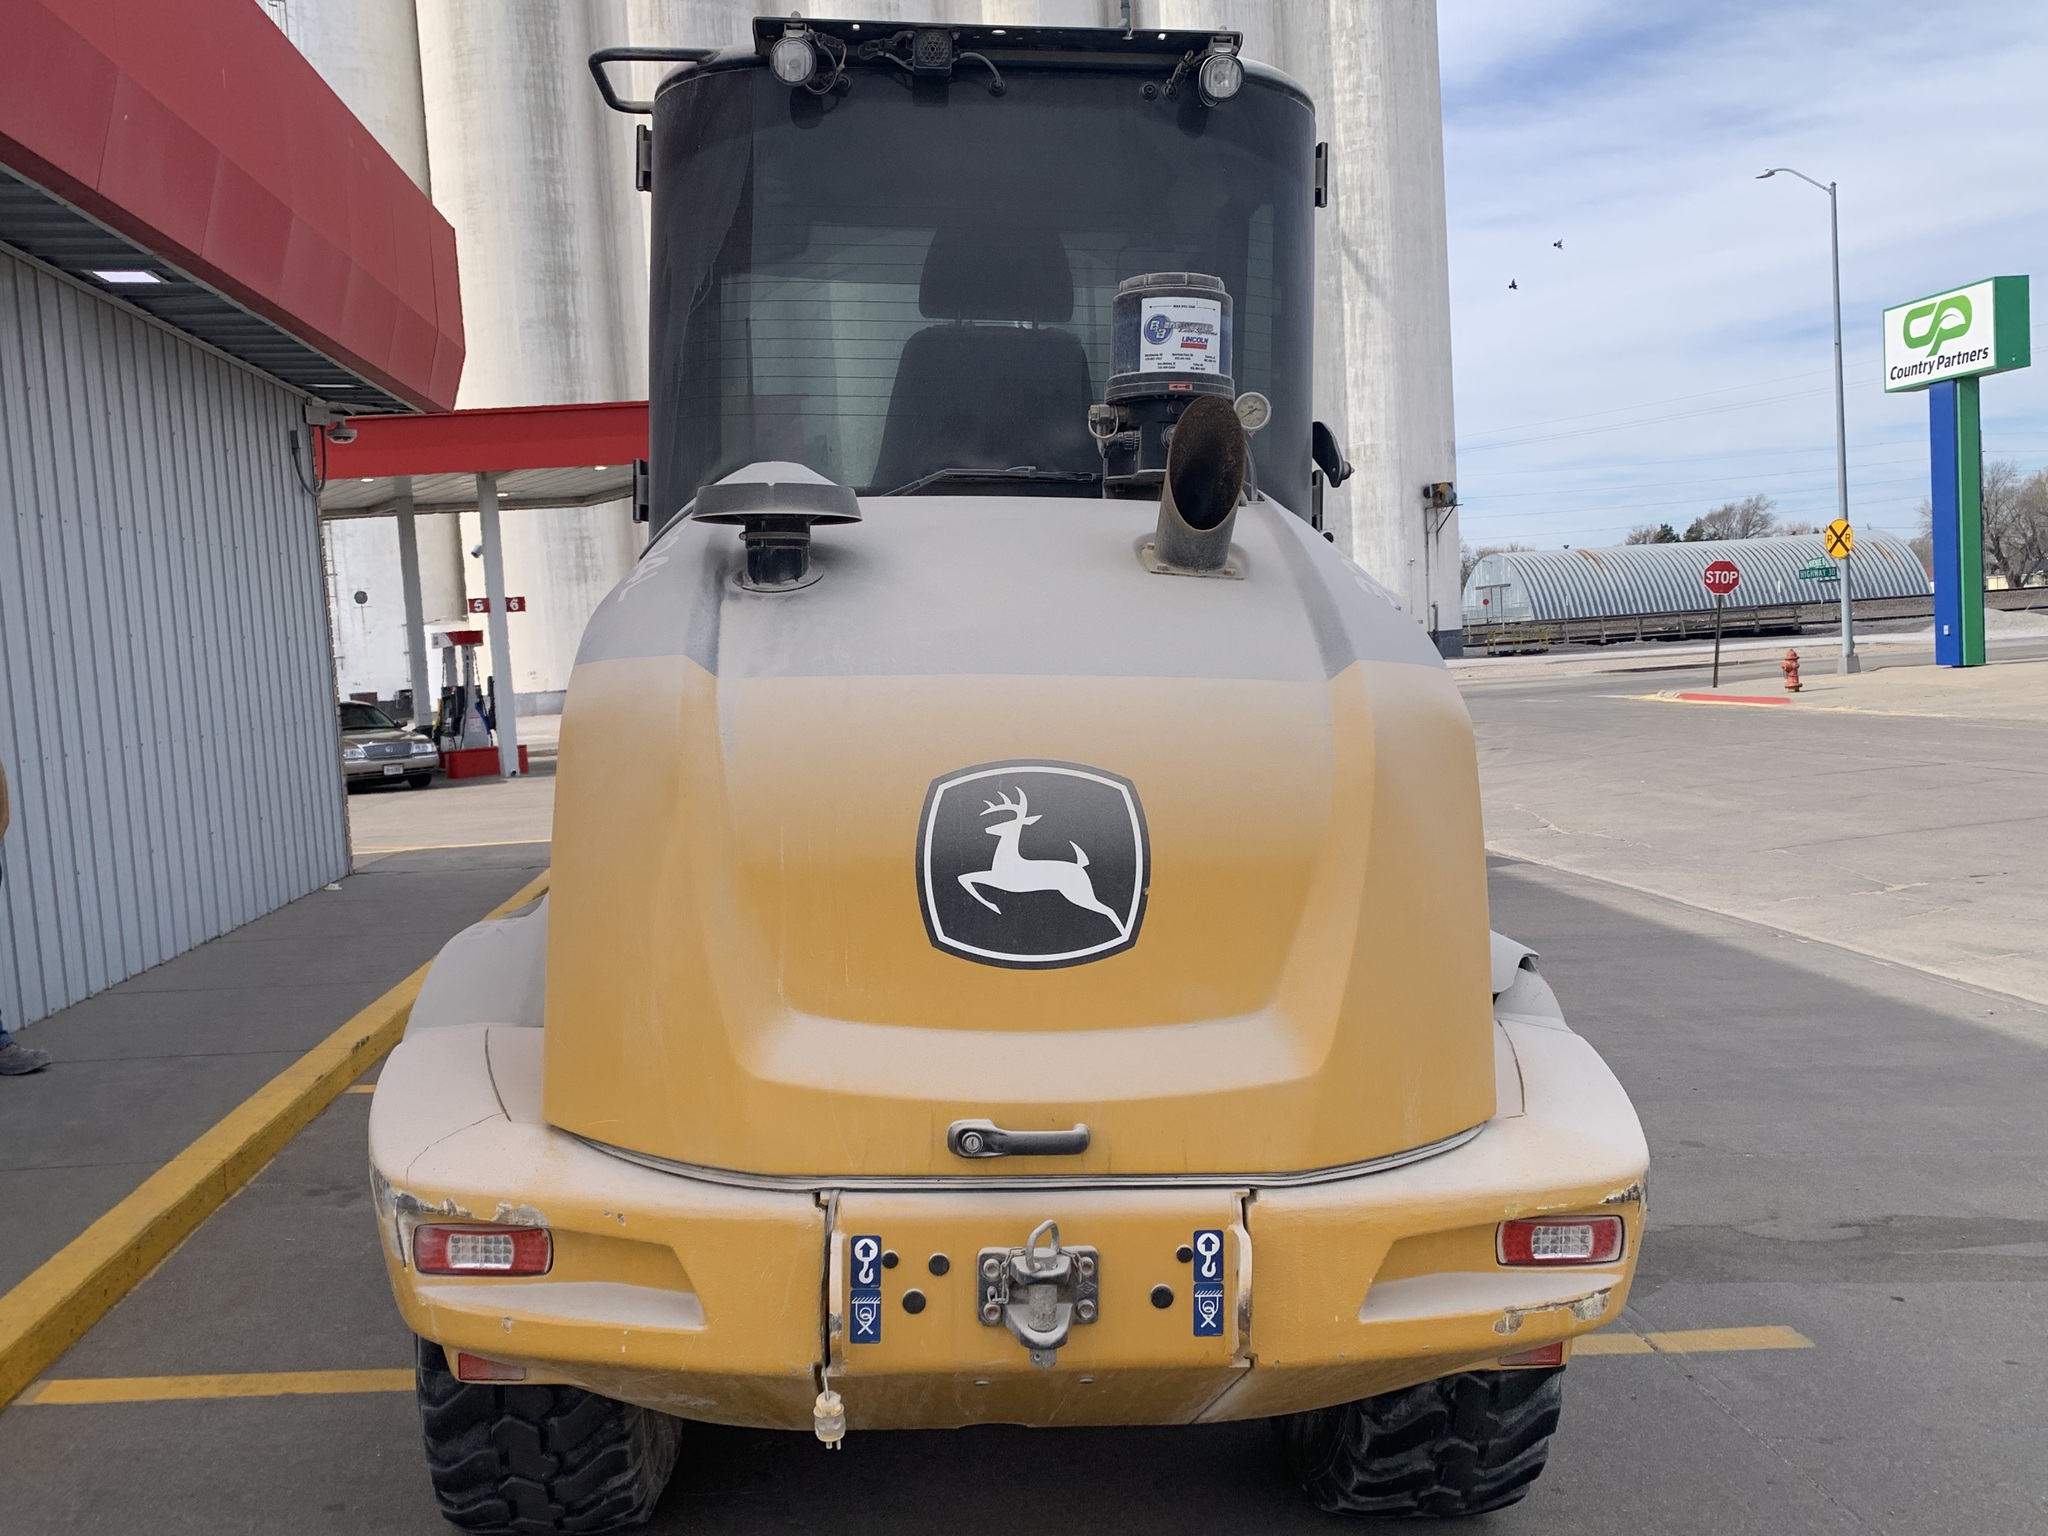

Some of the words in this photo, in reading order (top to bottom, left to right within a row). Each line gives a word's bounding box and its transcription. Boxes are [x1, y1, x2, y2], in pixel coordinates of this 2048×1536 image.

[1181, 336, 1209, 344] LINCOLN
[1889, 359, 1936, 381] Country
[1936, 346, 1990, 371] Partners
[1827, 534, 1833, 544] R
[1845, 533, 1851, 543] R
[1705, 570, 1739, 585] STOP
[1800, 569, 1827, 578] HIGHWAY
[1828, 567, 1836, 577] 30
[474, 599, 484, 612] 5
[509, 598, 519, 611] 6
